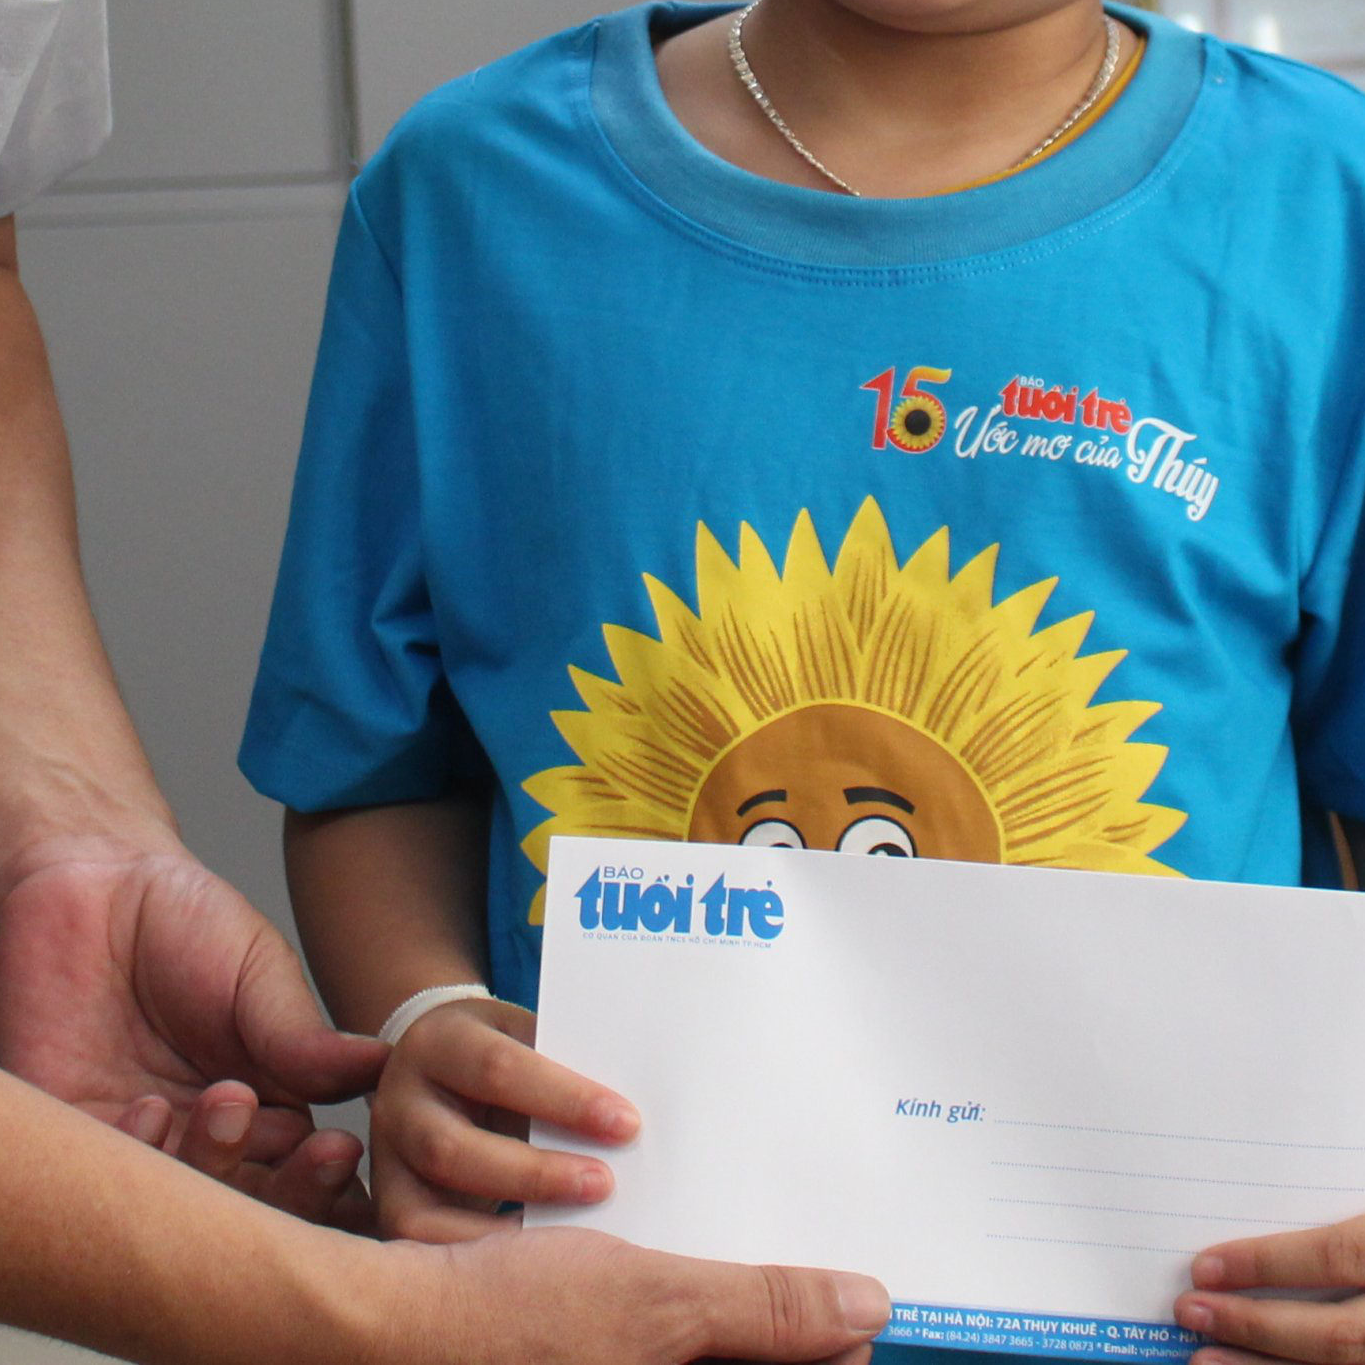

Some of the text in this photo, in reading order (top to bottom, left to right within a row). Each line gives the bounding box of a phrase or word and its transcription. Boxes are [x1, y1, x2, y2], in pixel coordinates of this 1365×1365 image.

[1019, 374, 1045, 388] BÁO
[999, 375, 1133, 435] tuổi trẻ
[859, 365, 1220, 522] 15 Ước mơ của Thúy
[603, 864, 644, 880] BÁO
[573, 865, 785, 940] tuổi trẻ
[895, 1097, 986, 1124] Kính gửi:
[895, 1306, 919, 1321] TRẺ
[921, 1310, 941, 1325] TẠI
[944, 1310, 963, 1325] HÀ
[966, 1313, 993, 1328] NỘI:
[996, 1317, 1021, 1330] 72A
[1023, 1319, 1059, 1334] THỤY
[1062, 1322, 1097, 1336] KHUÊ
[1107, 1326, 1121, 1338] Q.
[1123, 1326, 1146, 1340] TÂY
[1149, 1328, 1169, 1341] HỒ
[922, 1328, 944, 1340] Fax:
[983, 1335, 1006, 1345] 3847
[1009, 1335, 1033, 1347] 3665
[1043, 1338, 1067, 1350] 3728
[1104, 1343, 1138, 1355] Email:
